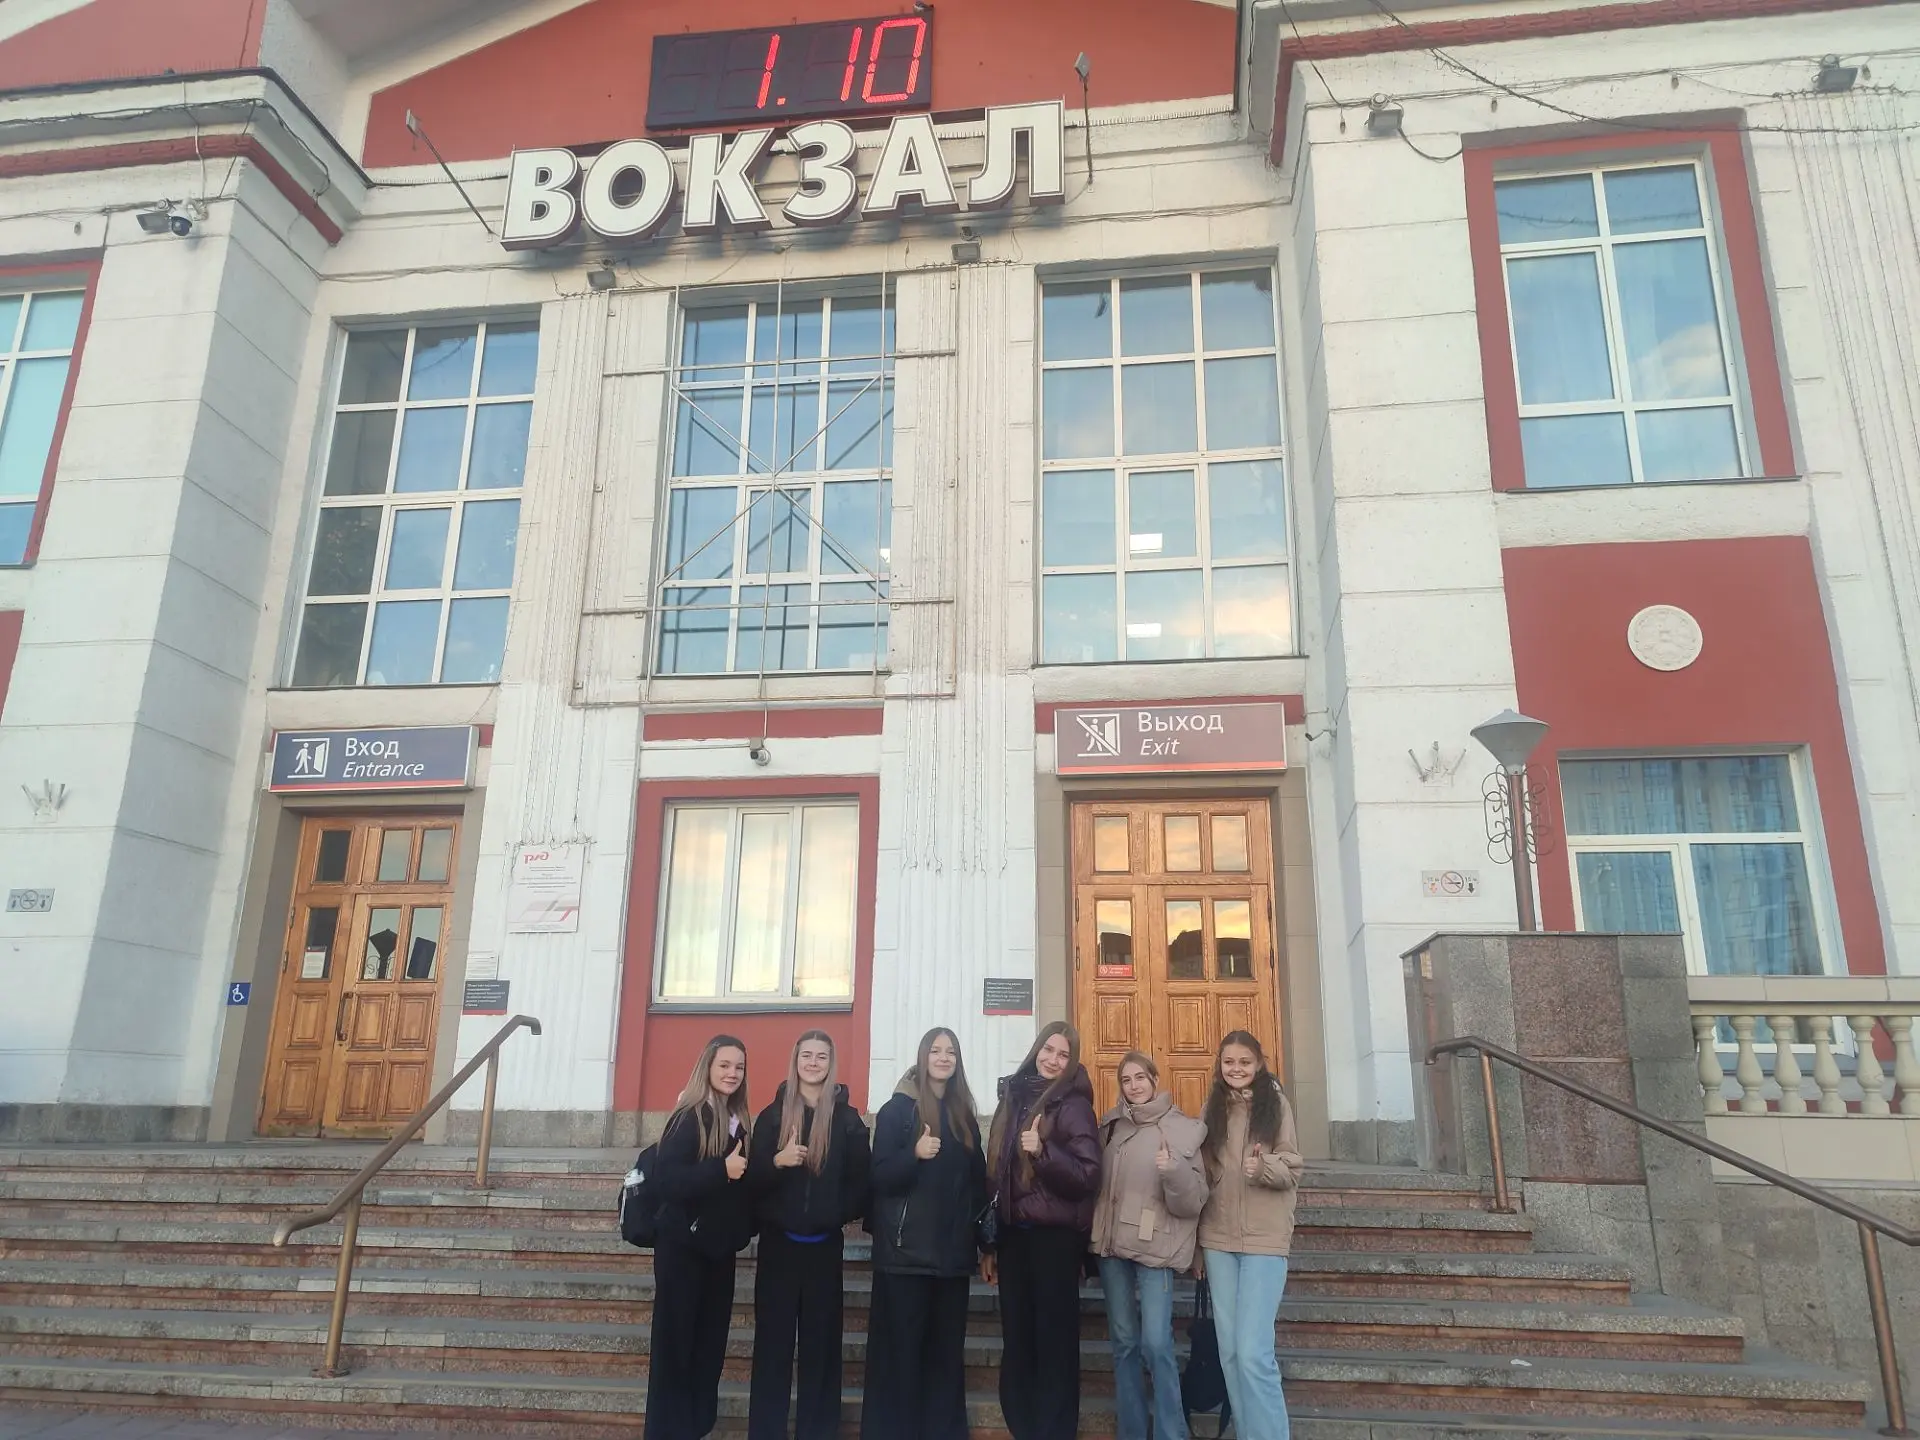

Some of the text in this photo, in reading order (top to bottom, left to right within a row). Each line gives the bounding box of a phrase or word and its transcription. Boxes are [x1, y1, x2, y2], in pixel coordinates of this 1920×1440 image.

[756, 17, 928, 108] 1.10
[501, 100, 1065, 245] ВОКЗАЛ
[1137, 711, 1224, 734] Выход
[344, 737, 400, 759] Вход
[1139, 738, 1181, 756] Exit
[342, 761, 425, 778] Entrance
